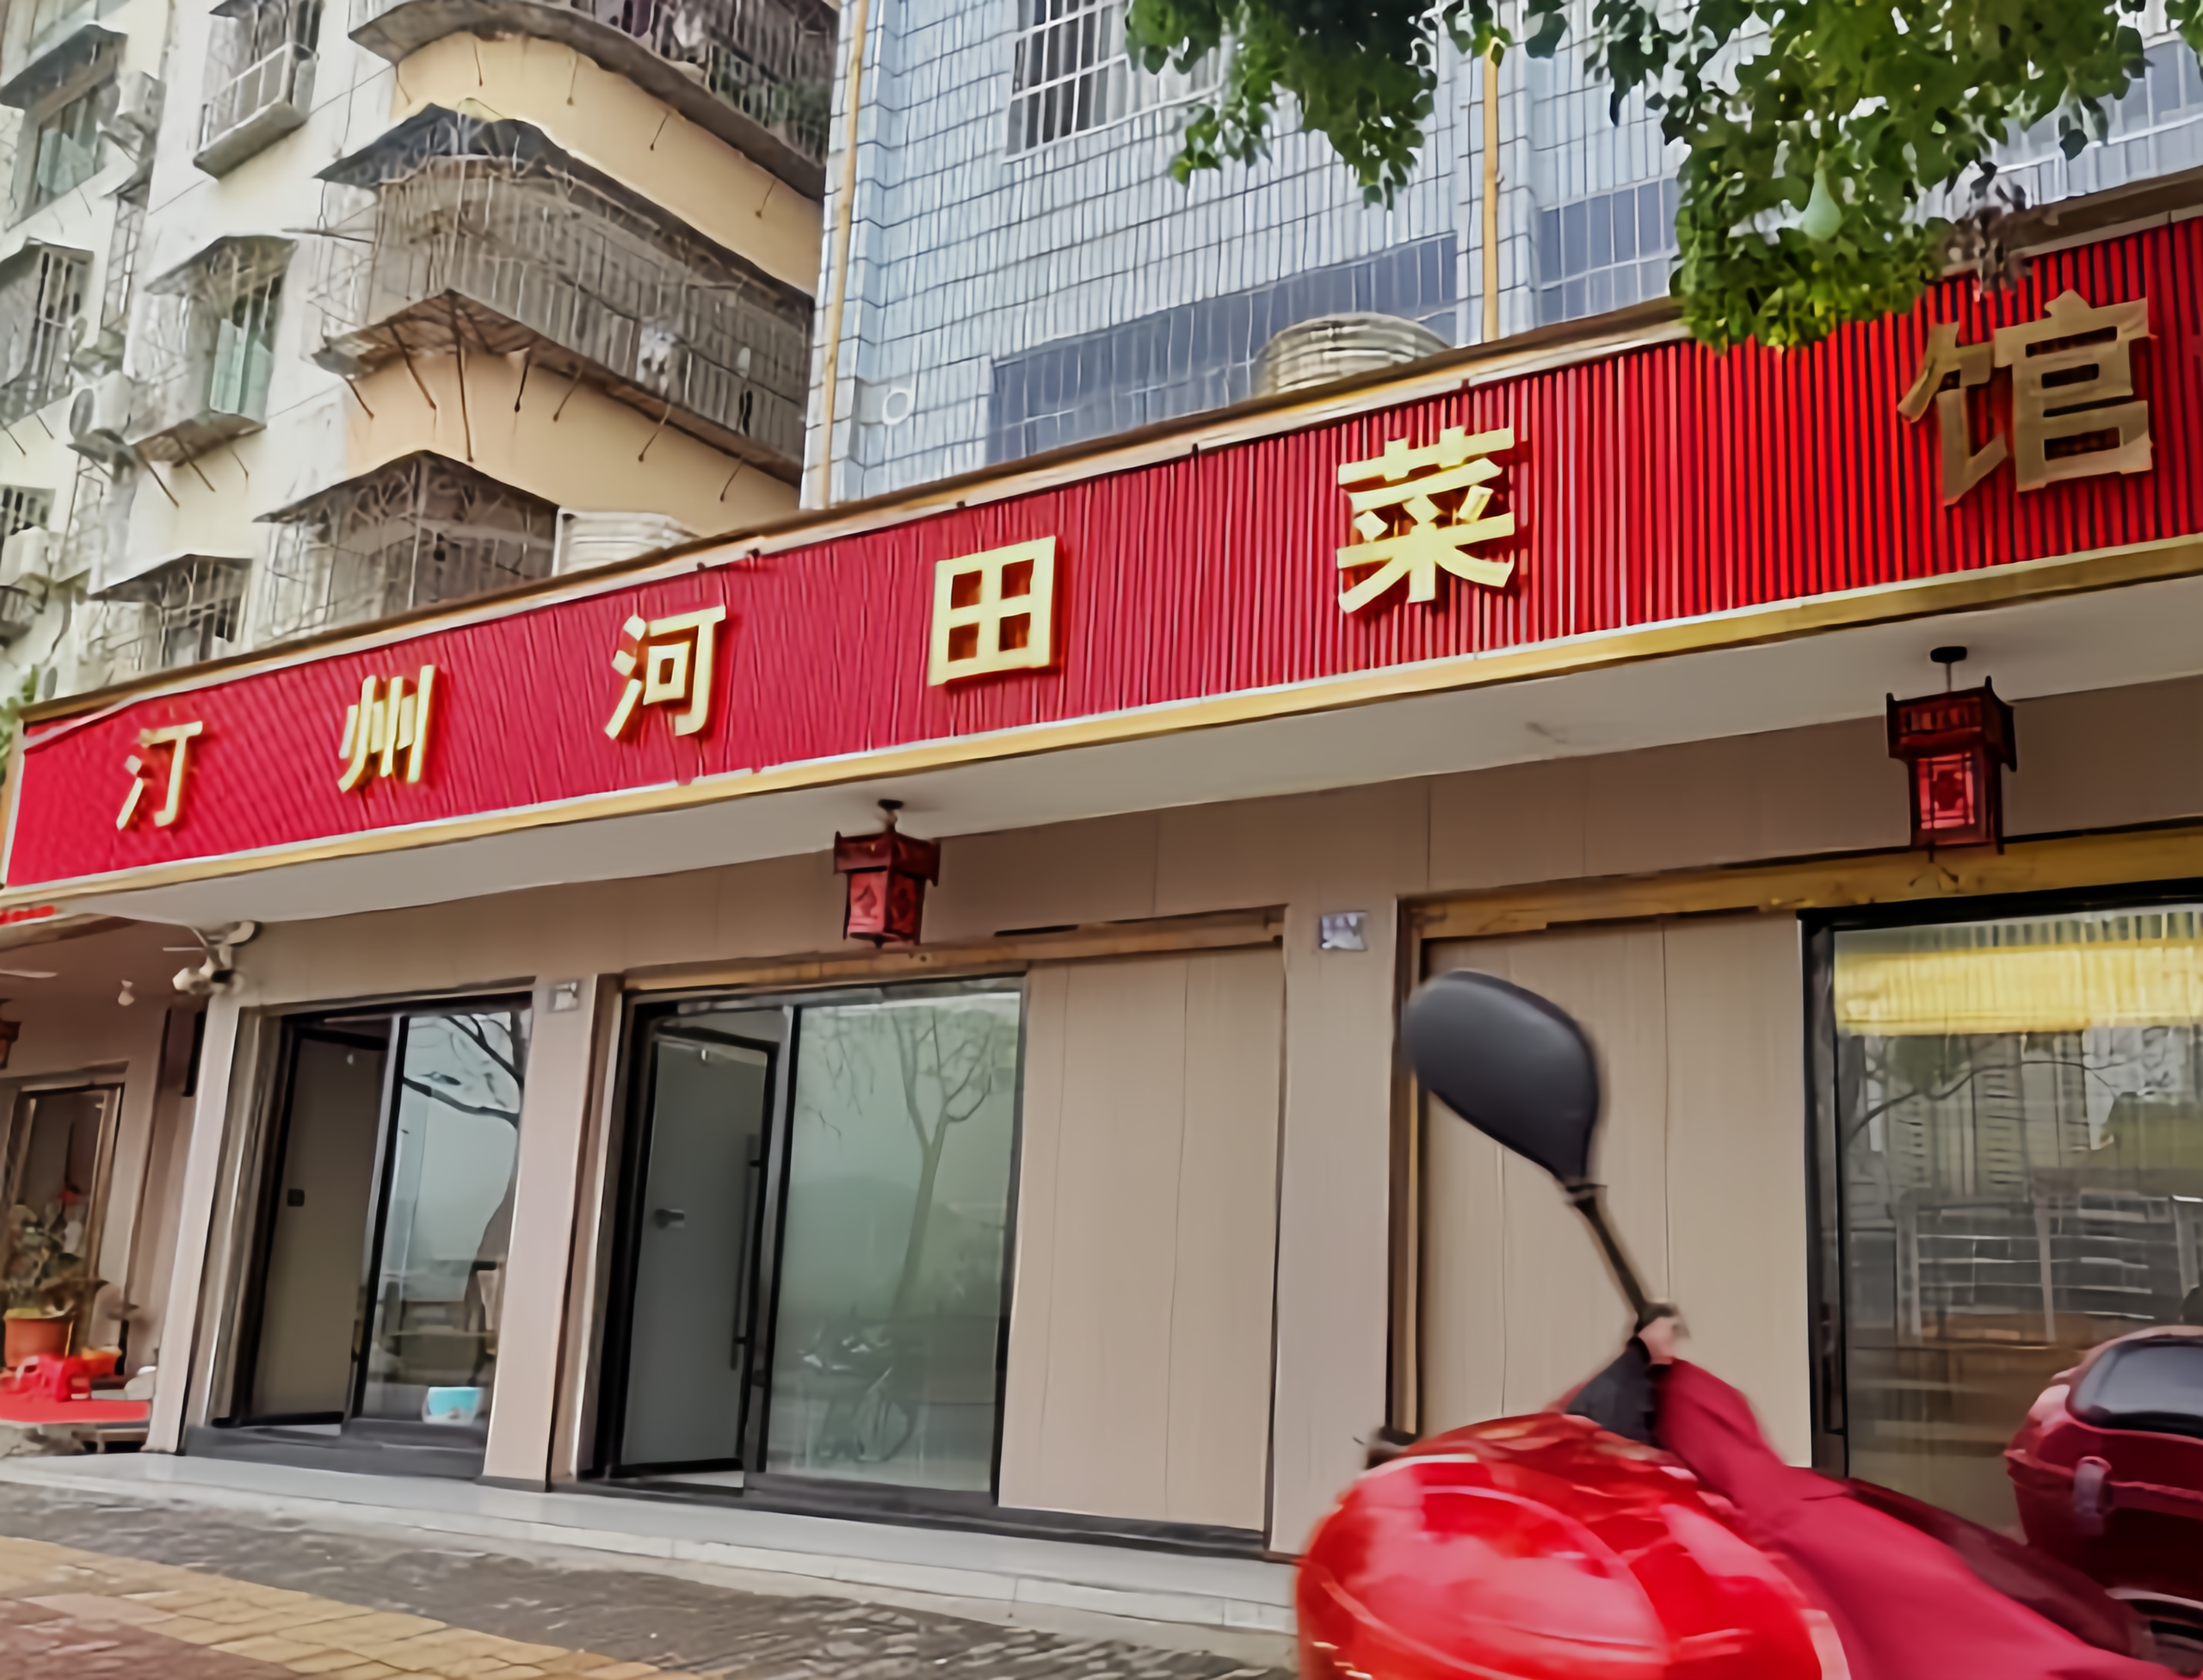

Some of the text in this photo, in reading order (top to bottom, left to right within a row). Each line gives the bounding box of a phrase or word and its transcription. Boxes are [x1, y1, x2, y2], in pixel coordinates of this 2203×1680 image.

[116, 288, 2153, 831] 汀州河田菜馆
